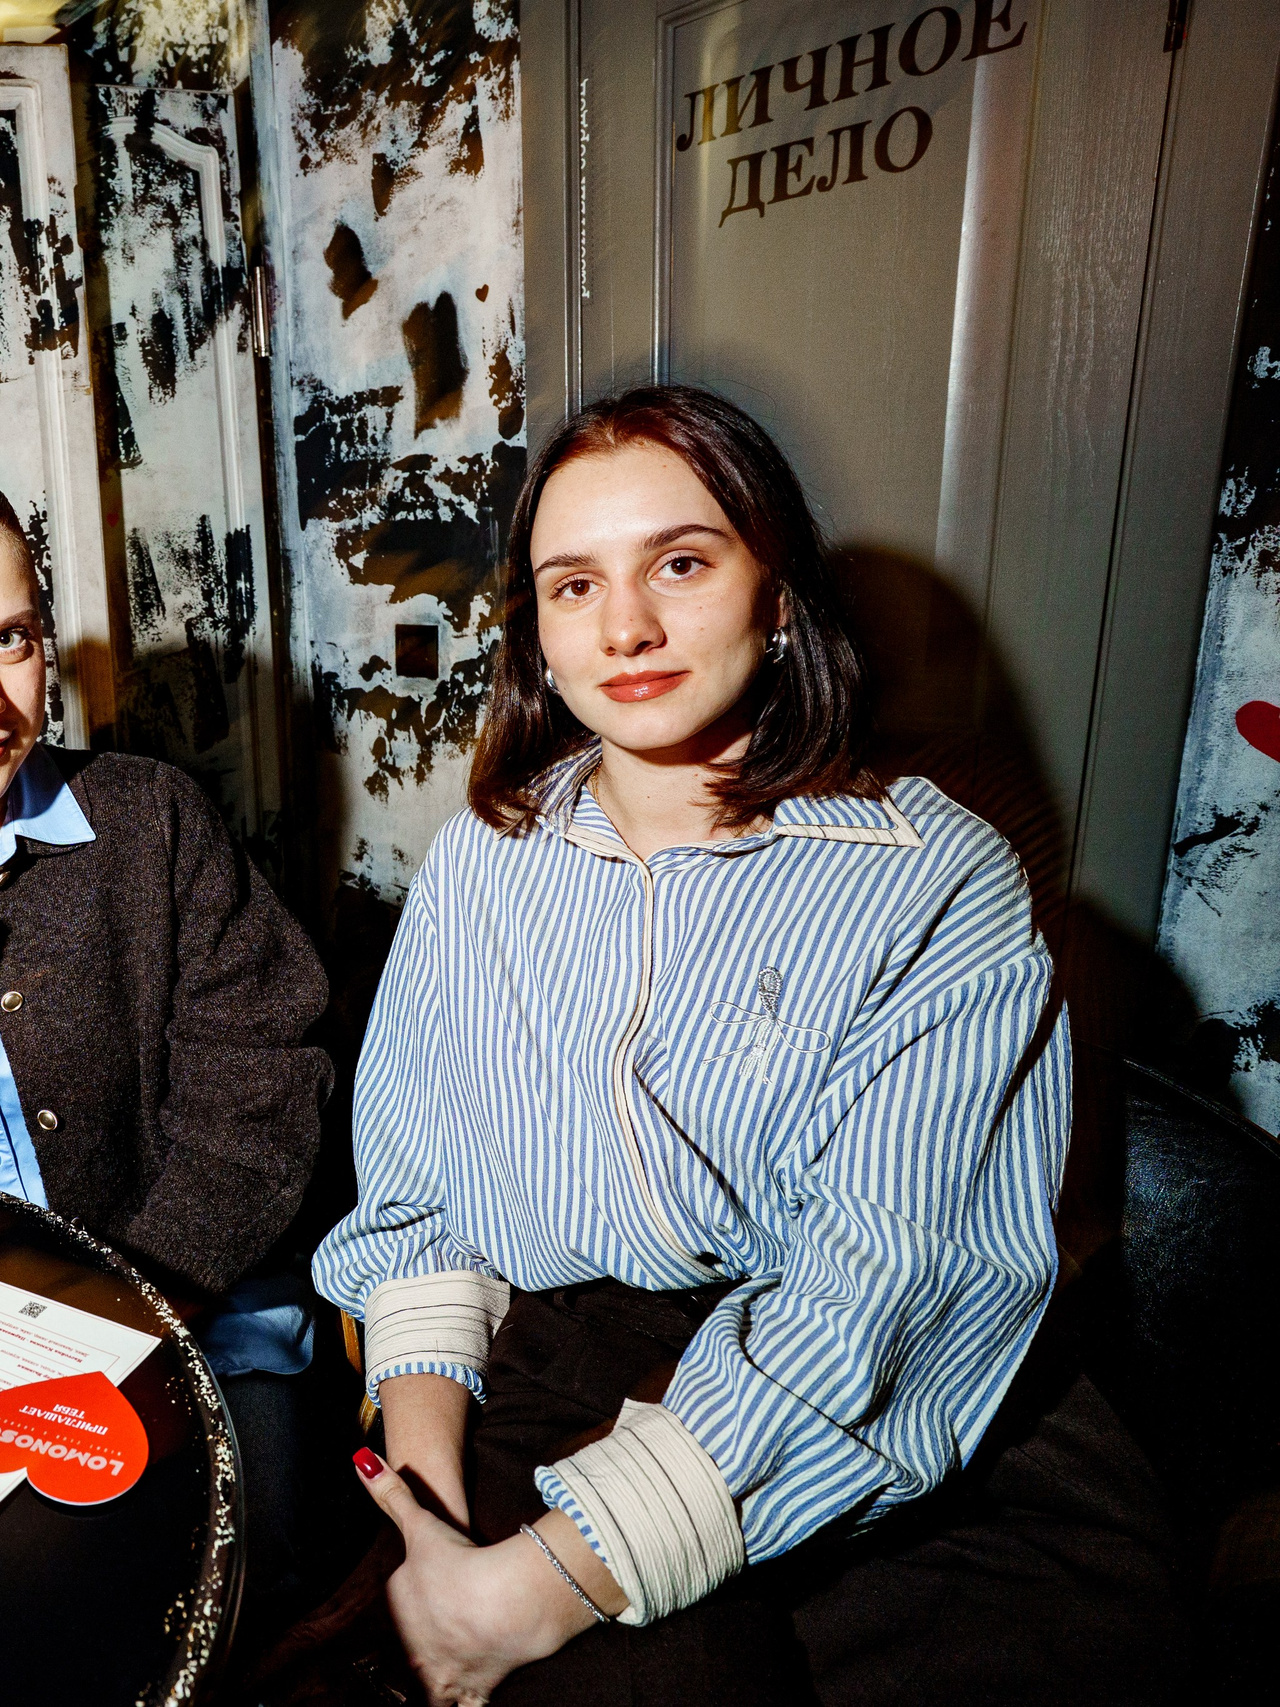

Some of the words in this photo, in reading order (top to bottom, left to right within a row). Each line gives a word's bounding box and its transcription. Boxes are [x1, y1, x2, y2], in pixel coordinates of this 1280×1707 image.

[677, 0, 1027, 152] ЛИЧНОЕ
[718, 106, 933, 228] ДЕЛО
[18, 1404, 109, 1436] ПРИГЛАШАЕТ
[52, 1403, 86, 1420] ТЕБЯ
